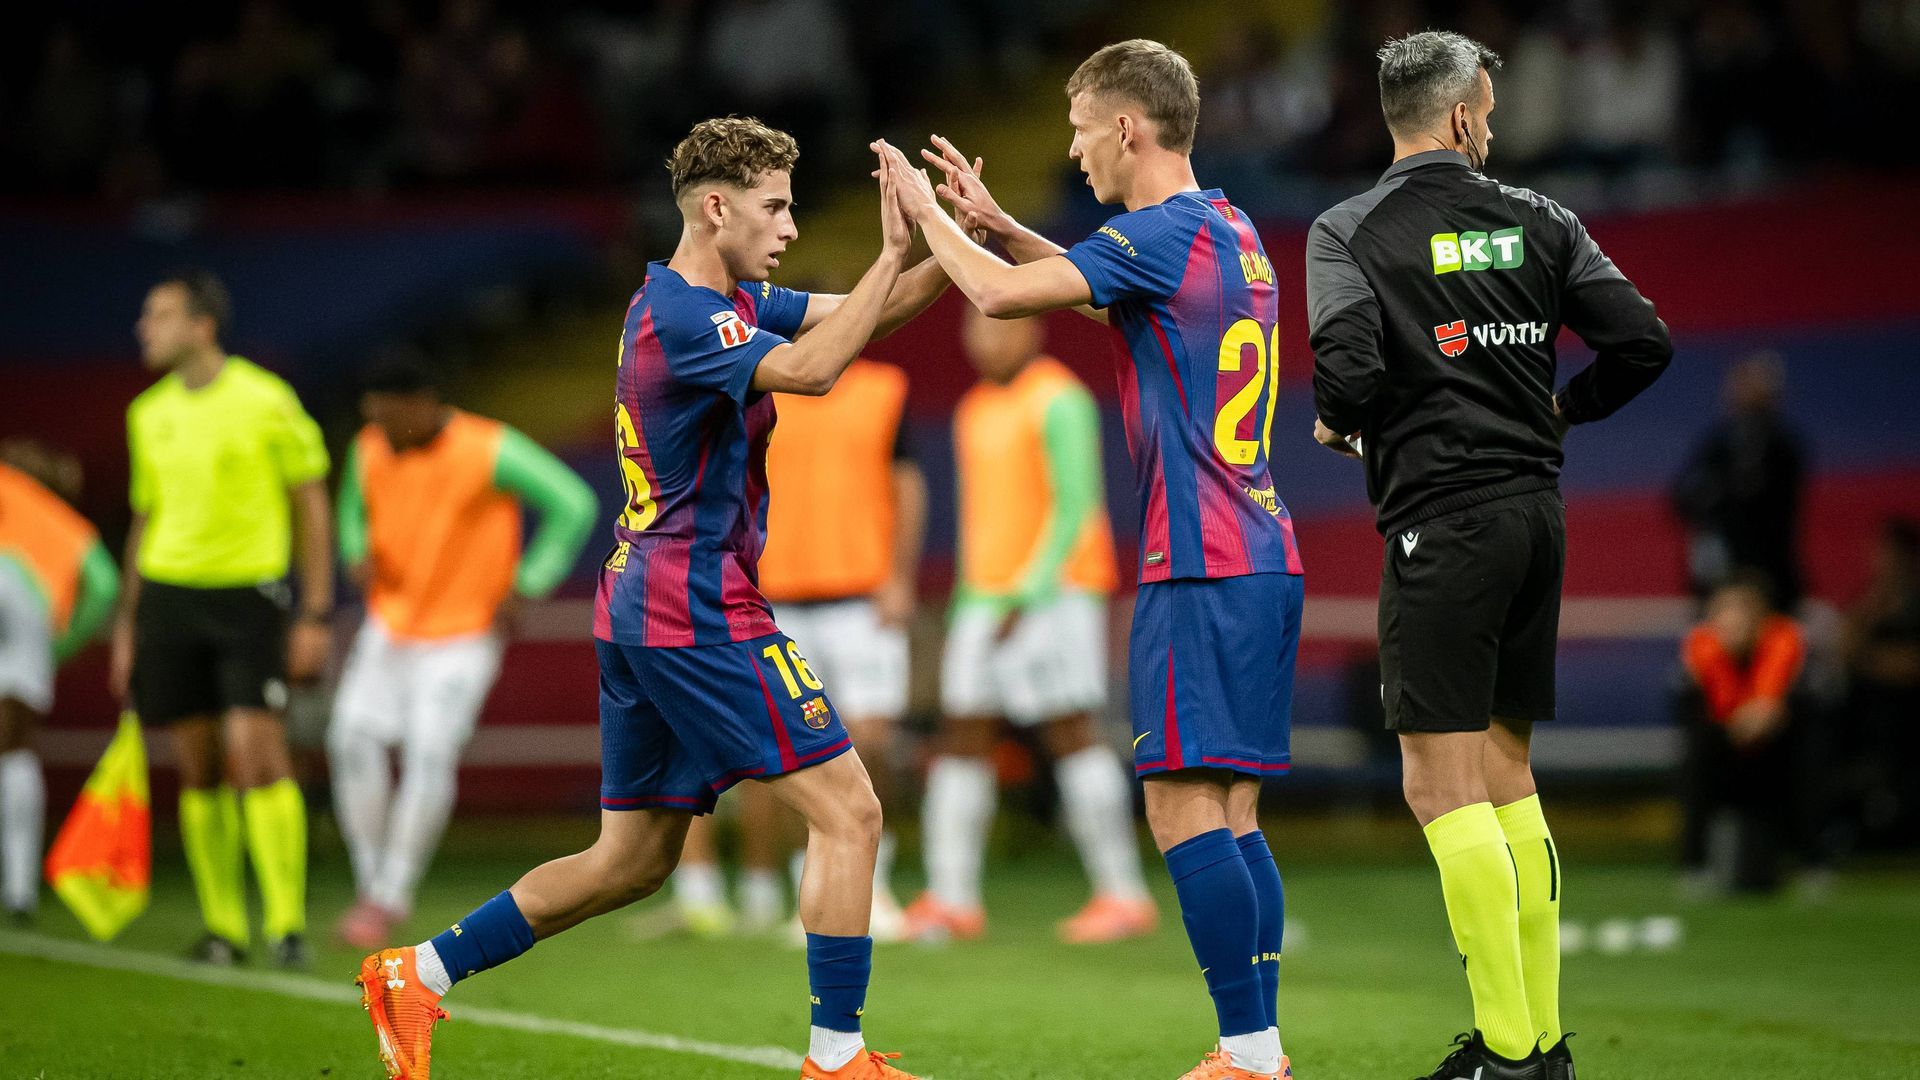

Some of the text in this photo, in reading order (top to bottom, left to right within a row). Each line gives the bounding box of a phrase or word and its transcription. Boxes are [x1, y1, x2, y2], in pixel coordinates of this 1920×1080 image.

[1433, 233, 1521, 268] BKT
[1239, 252, 1273, 285] OLMO
[763, 640, 824, 700] 16
